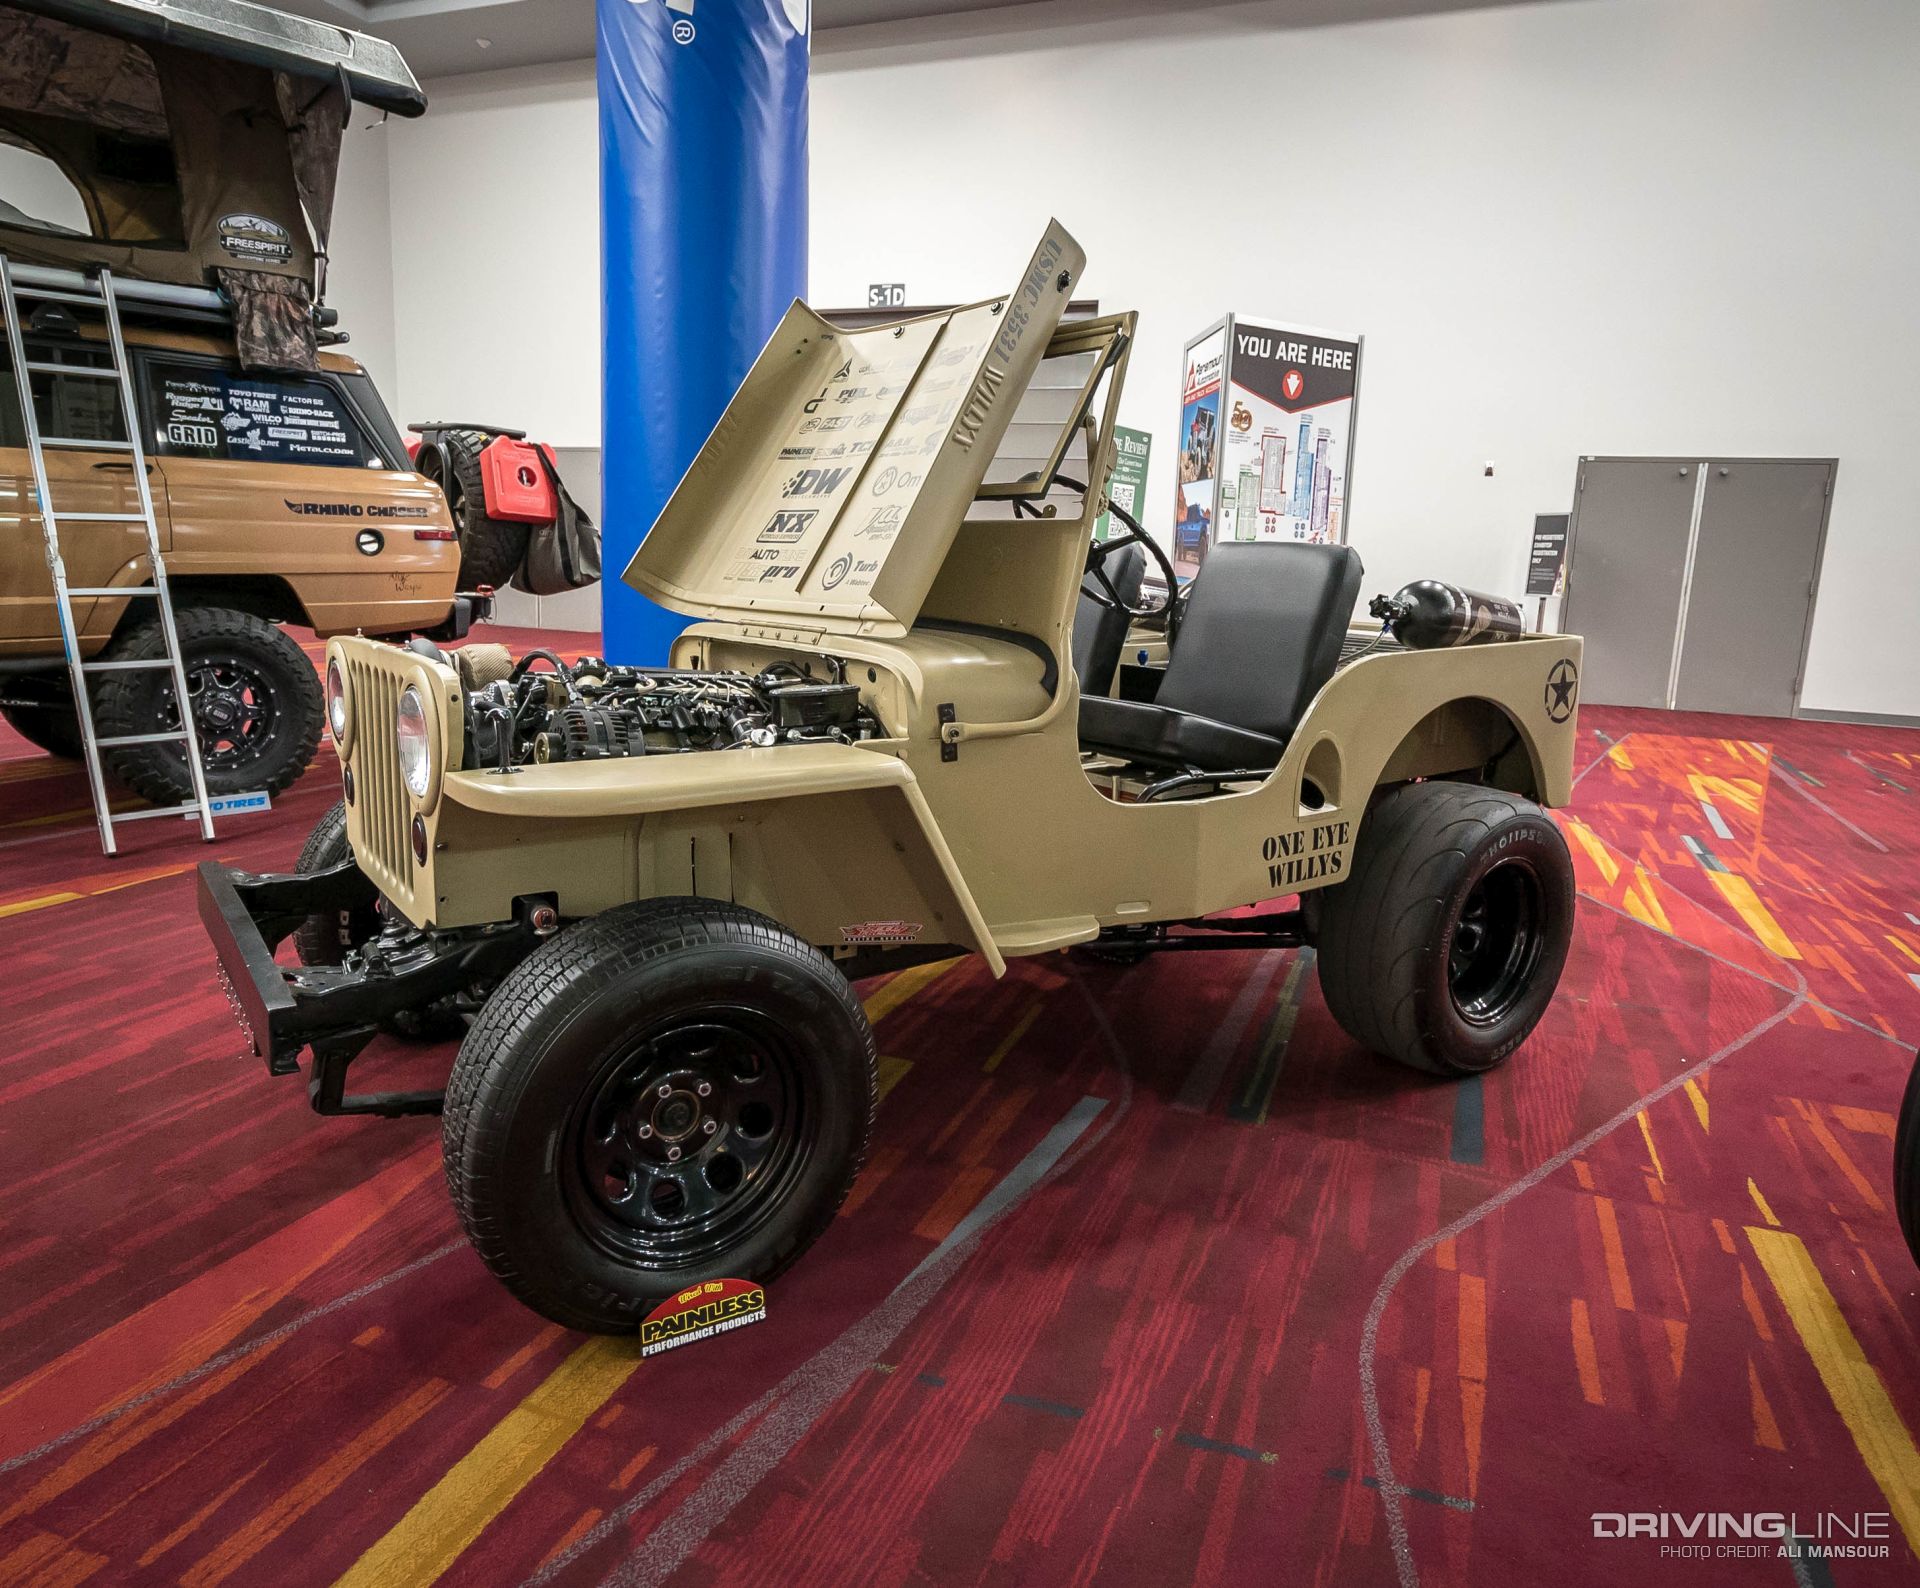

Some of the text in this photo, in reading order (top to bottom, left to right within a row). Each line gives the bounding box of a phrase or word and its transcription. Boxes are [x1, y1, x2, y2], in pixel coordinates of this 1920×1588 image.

[226, 236, 287, 254] FREESPIRIT
[870, 288, 904, 306] S-1D
[994, 238, 1063, 363] USMC 3531
[1238, 334, 1352, 370] YOU ARE HERE
[228, 389, 277, 400] TOYO TIRES
[283, 395, 312, 405] FACTOR
[171, 400, 200, 409] Ridge
[244, 399, 269, 409] RAM
[252, 413, 282, 423] WILCO
[170, 425, 216, 445] GRID
[793, 467, 853, 496] DW
[304, 503, 428, 518] RHINO CHASER
[766, 513, 815, 533] NX
[750, 550, 779, 560] AUTO
[226, 797, 265, 809] TIRES
[1262, 822, 1350, 861] ONE EYE
[1268, 851, 1342, 888] WILLYS
[642, 1290, 764, 1344] PAINLESS
[642, 1309, 767, 1357] PERFORMANCE PRODUCTS
